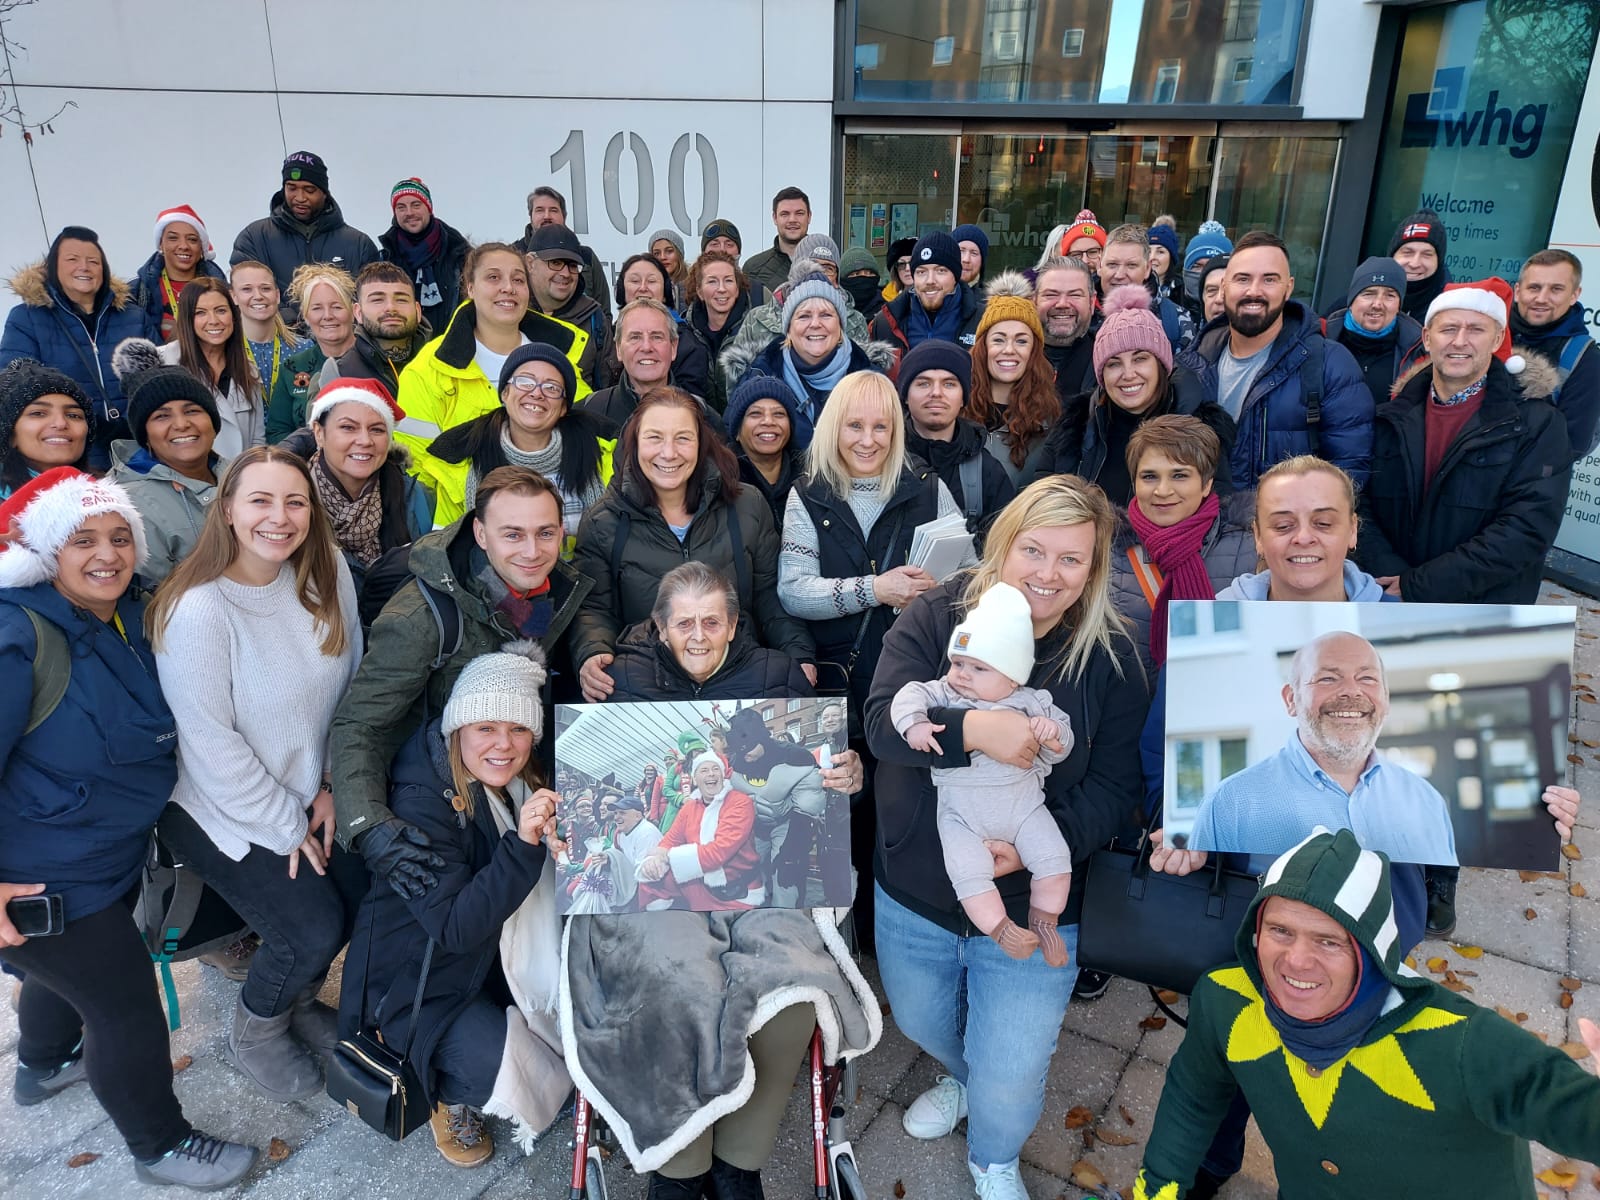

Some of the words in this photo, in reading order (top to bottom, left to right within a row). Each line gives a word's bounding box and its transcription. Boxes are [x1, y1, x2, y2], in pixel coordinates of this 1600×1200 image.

[1445, 90, 1549, 159] whg
[550, 130, 720, 236] 100
[1421, 192, 1495, 214] Welcome
[1465, 222, 1500, 240] times
[1446, 254, 1477, 270] 09:00
[1489, 257, 1521, 274] 17:00
[1568, 487, 1591, 503] with
